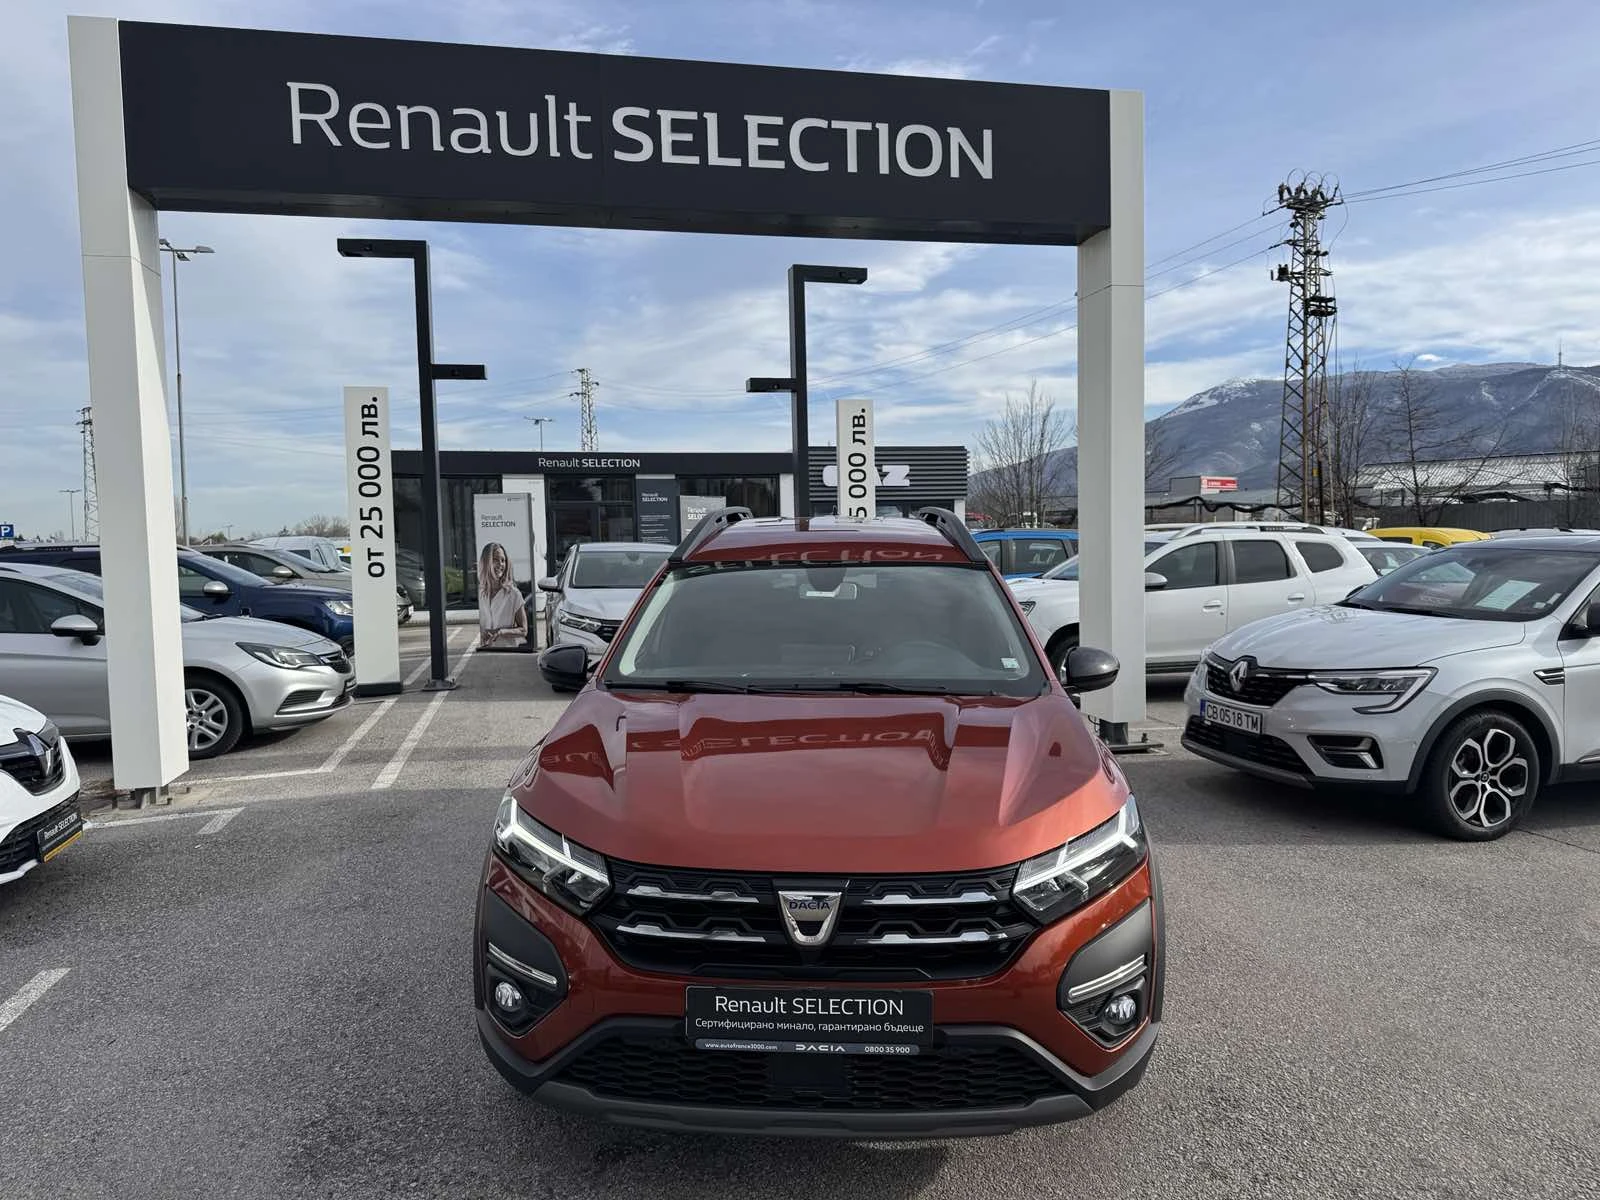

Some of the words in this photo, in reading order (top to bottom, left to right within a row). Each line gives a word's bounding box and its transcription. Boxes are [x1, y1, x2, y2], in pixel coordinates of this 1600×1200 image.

[286, 81, 594, 160] Renault
[612, 105, 994, 180] SELECTION
[361, 396, 379, 438] лв.
[852, 408, 866, 445] лв.
[357, 446, 382, 498] 000
[538, 457, 580, 468] Renault
[581, 458, 640, 468] SELECTION
[848, 452, 867, 499] 000
[360, 506, 384, 539] 25
[367, 547, 385, 578] от
[1219, 708, 1243, 727] 0518
[789, 901, 830, 910] DACIA
[715, 995, 787, 1015] Renault
[792, 997, 904, 1016] SELECTION
[695, 1017, 775, 1031] Сертифицирано
[776, 1021, 816, 1032] минало,
[818, 1023, 882, 1033] гарантирано
[883, 1021, 924, 1034] бъдеще
[704, 1041, 778, 1051] www.autofrance3000.com
[795, 1044, 846, 1052] DACIA
[864, 1046, 885, 1054] 0800
